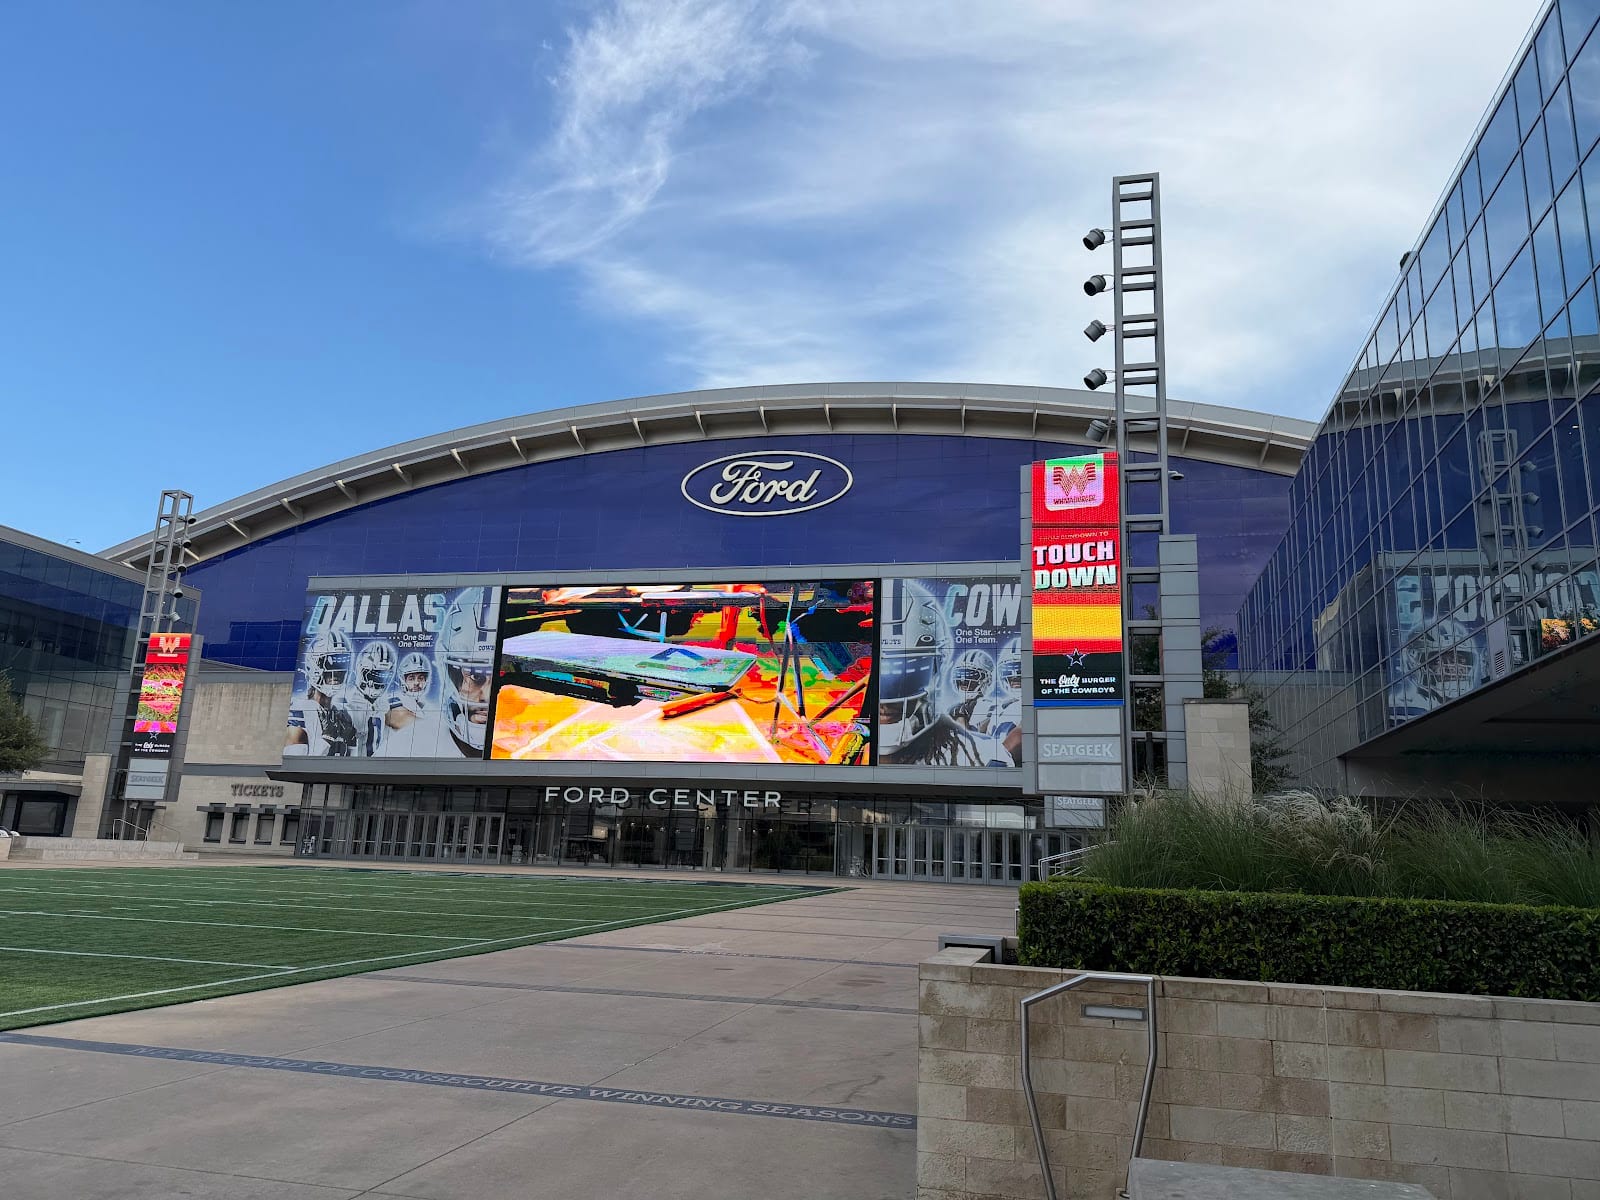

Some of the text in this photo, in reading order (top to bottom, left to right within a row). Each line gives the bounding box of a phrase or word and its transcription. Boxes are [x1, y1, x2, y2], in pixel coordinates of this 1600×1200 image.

[710, 460, 822, 504] Ford
[1033, 540, 1115, 566] TOUCH
[1034, 564, 1117, 590] DOWN
[306, 593, 447, 634] DALLAS
[955, 628, 994, 636] One Star.
[955, 636, 998, 644] One Team.
[1058, 674, 1080, 688] Only
[1042, 743, 1114, 758] SEATGEEK
[231, 783, 284, 798] TICKETS
[544, 786, 630, 804] FORD
[648, 788, 783, 808] CENTER
[1056, 797, 1100, 807] SEATGEEK
[189, 1052, 308, 1069] RECORD
[312, 1062, 361, 1075] OF
[359, 1068, 583, 1096] CONSECUTIVE
[588, 1088, 742, 1111] WINNING
[746, 1103, 914, 1126] SEASONS
